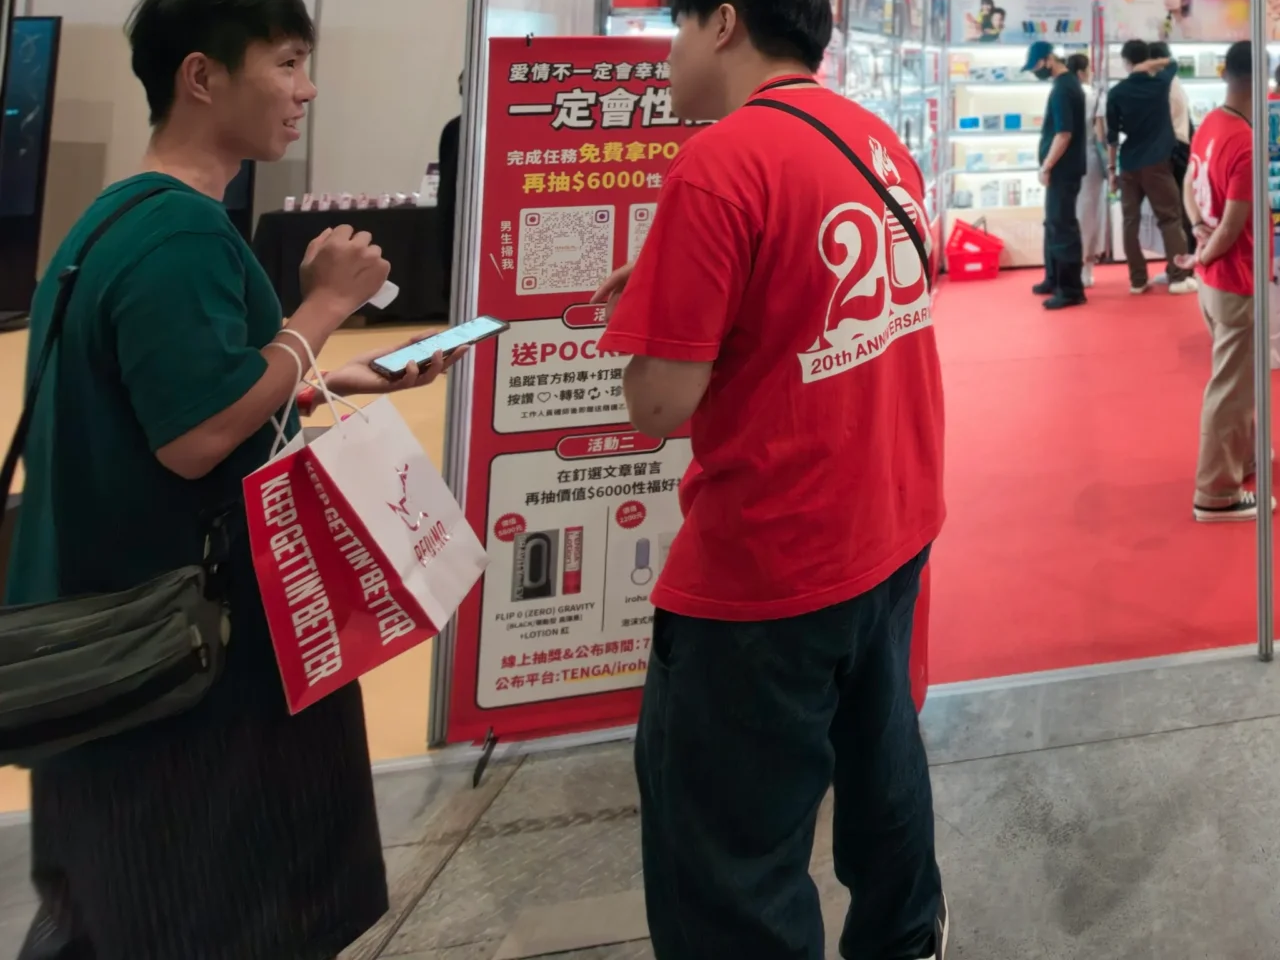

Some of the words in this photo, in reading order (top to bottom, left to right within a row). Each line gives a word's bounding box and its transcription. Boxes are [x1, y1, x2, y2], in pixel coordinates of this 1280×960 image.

[508, 87, 718, 130] 一定會性
[810, 350, 852, 375] 20th
[587, 436, 634, 453] 活動二
[557, 461, 662, 483] 在釘選文章留言
[304, 460, 330, 510] KEEP
[359, 566, 417, 646] BETTER
[260, 472, 297, 527] KEEP
[291, 596, 343, 688] BETTER
[558, 602, 595, 613] GRAVITY
